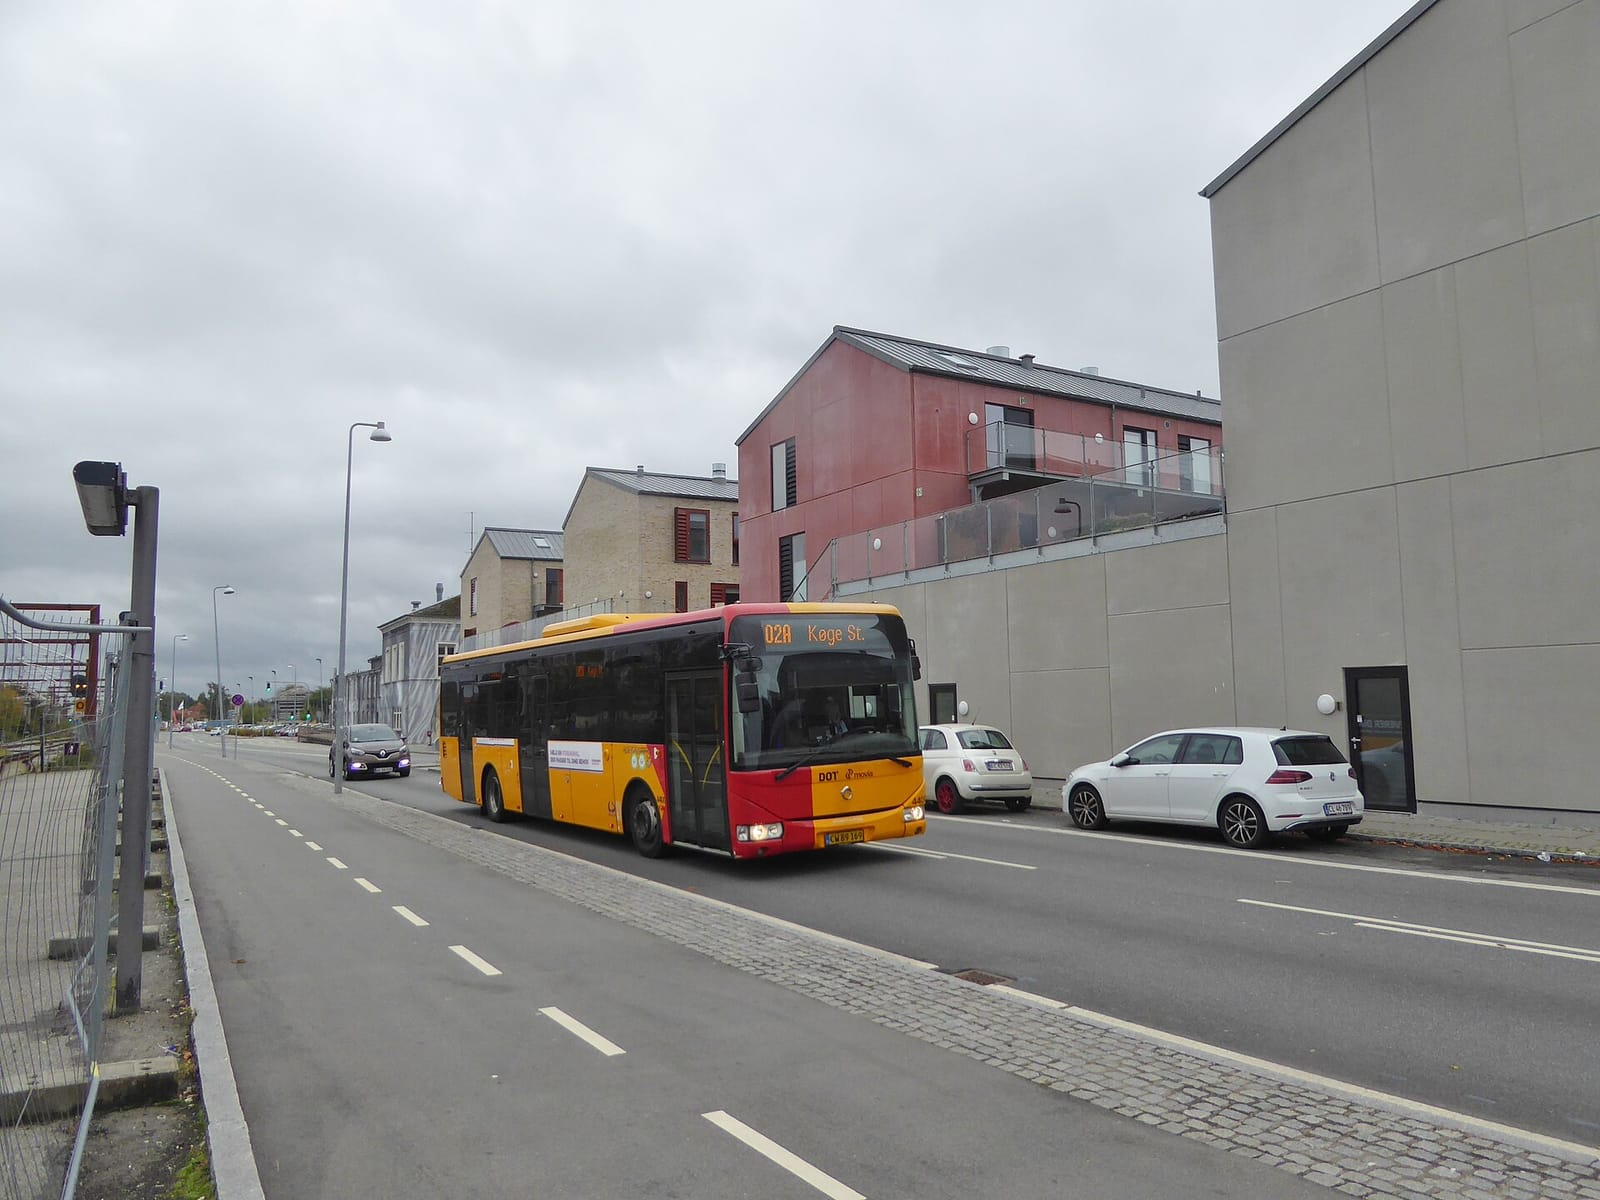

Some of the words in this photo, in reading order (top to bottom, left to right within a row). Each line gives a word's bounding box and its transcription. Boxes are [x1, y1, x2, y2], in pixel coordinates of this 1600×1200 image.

[765, 624, 792, 644] 02A
[808, 624, 842, 645] Køge
[847, 624, 865, 641] St.
[819, 771, 838, 782] DOT
